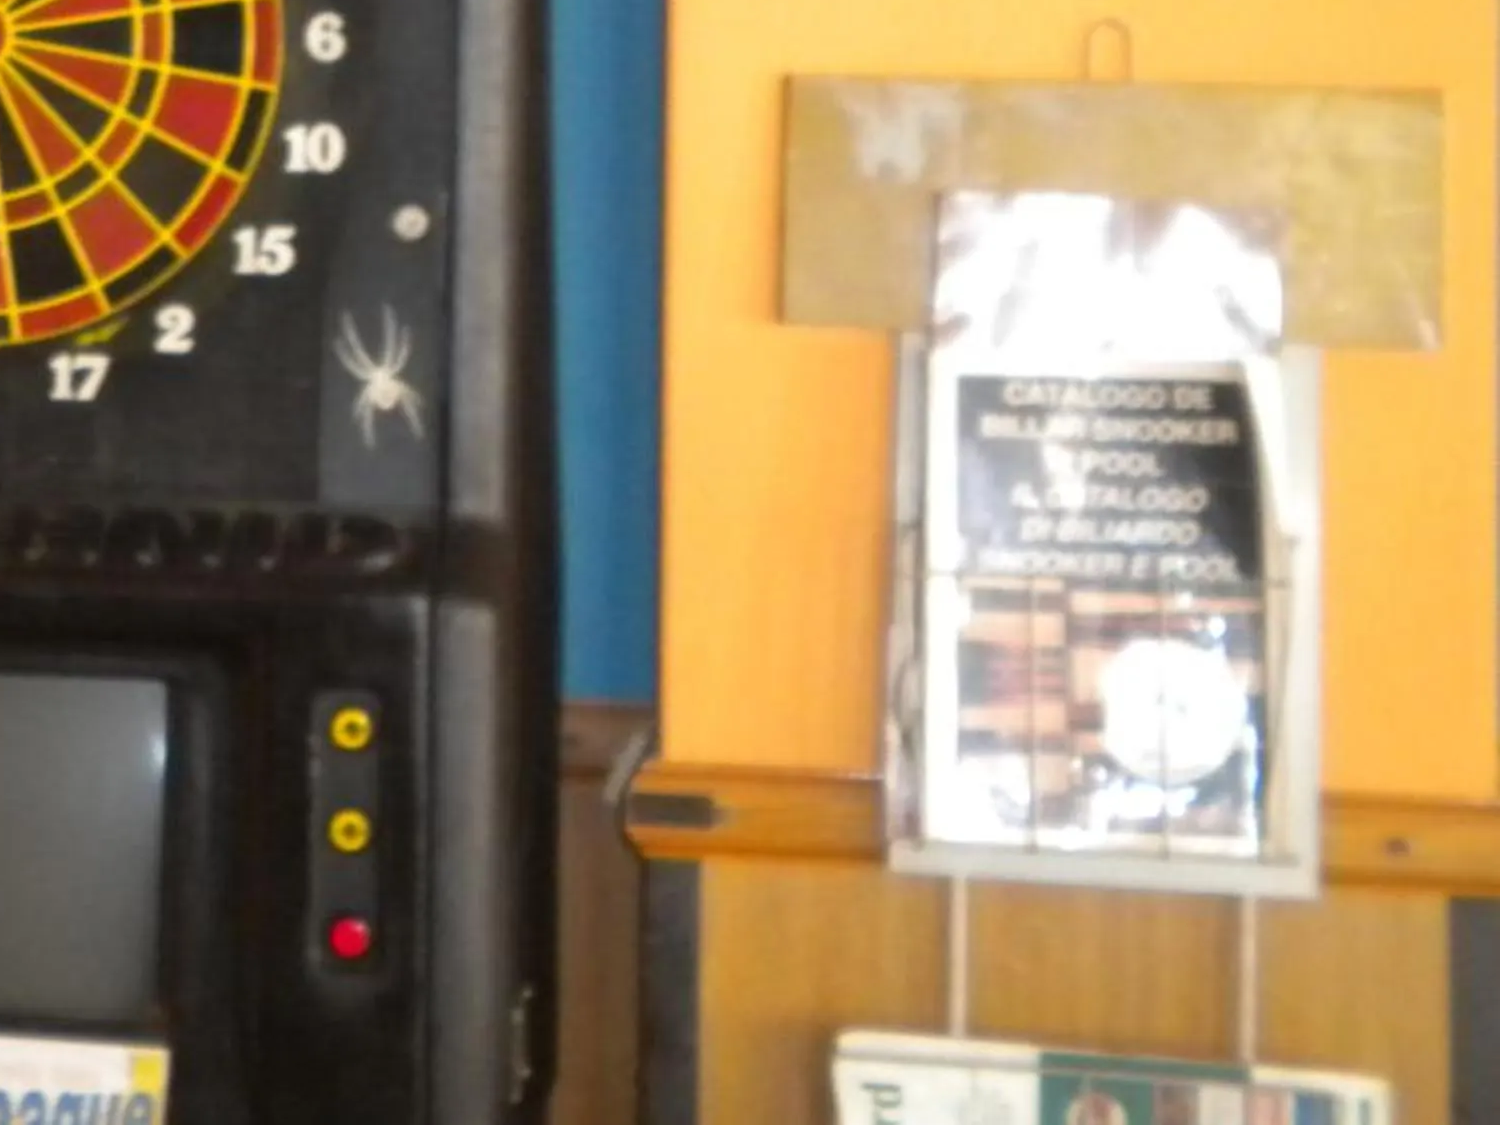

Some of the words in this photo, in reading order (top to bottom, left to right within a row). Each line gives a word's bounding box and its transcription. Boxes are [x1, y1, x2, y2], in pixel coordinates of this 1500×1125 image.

[301, 10, 348, 65] 6
[280, 120, 348, 175] 10
[231, 223, 298, 277] 15
[152, 302, 197, 356] 2
[47, 351, 112, 403] 17
[1045, 483, 1211, 513] CTALOGO
